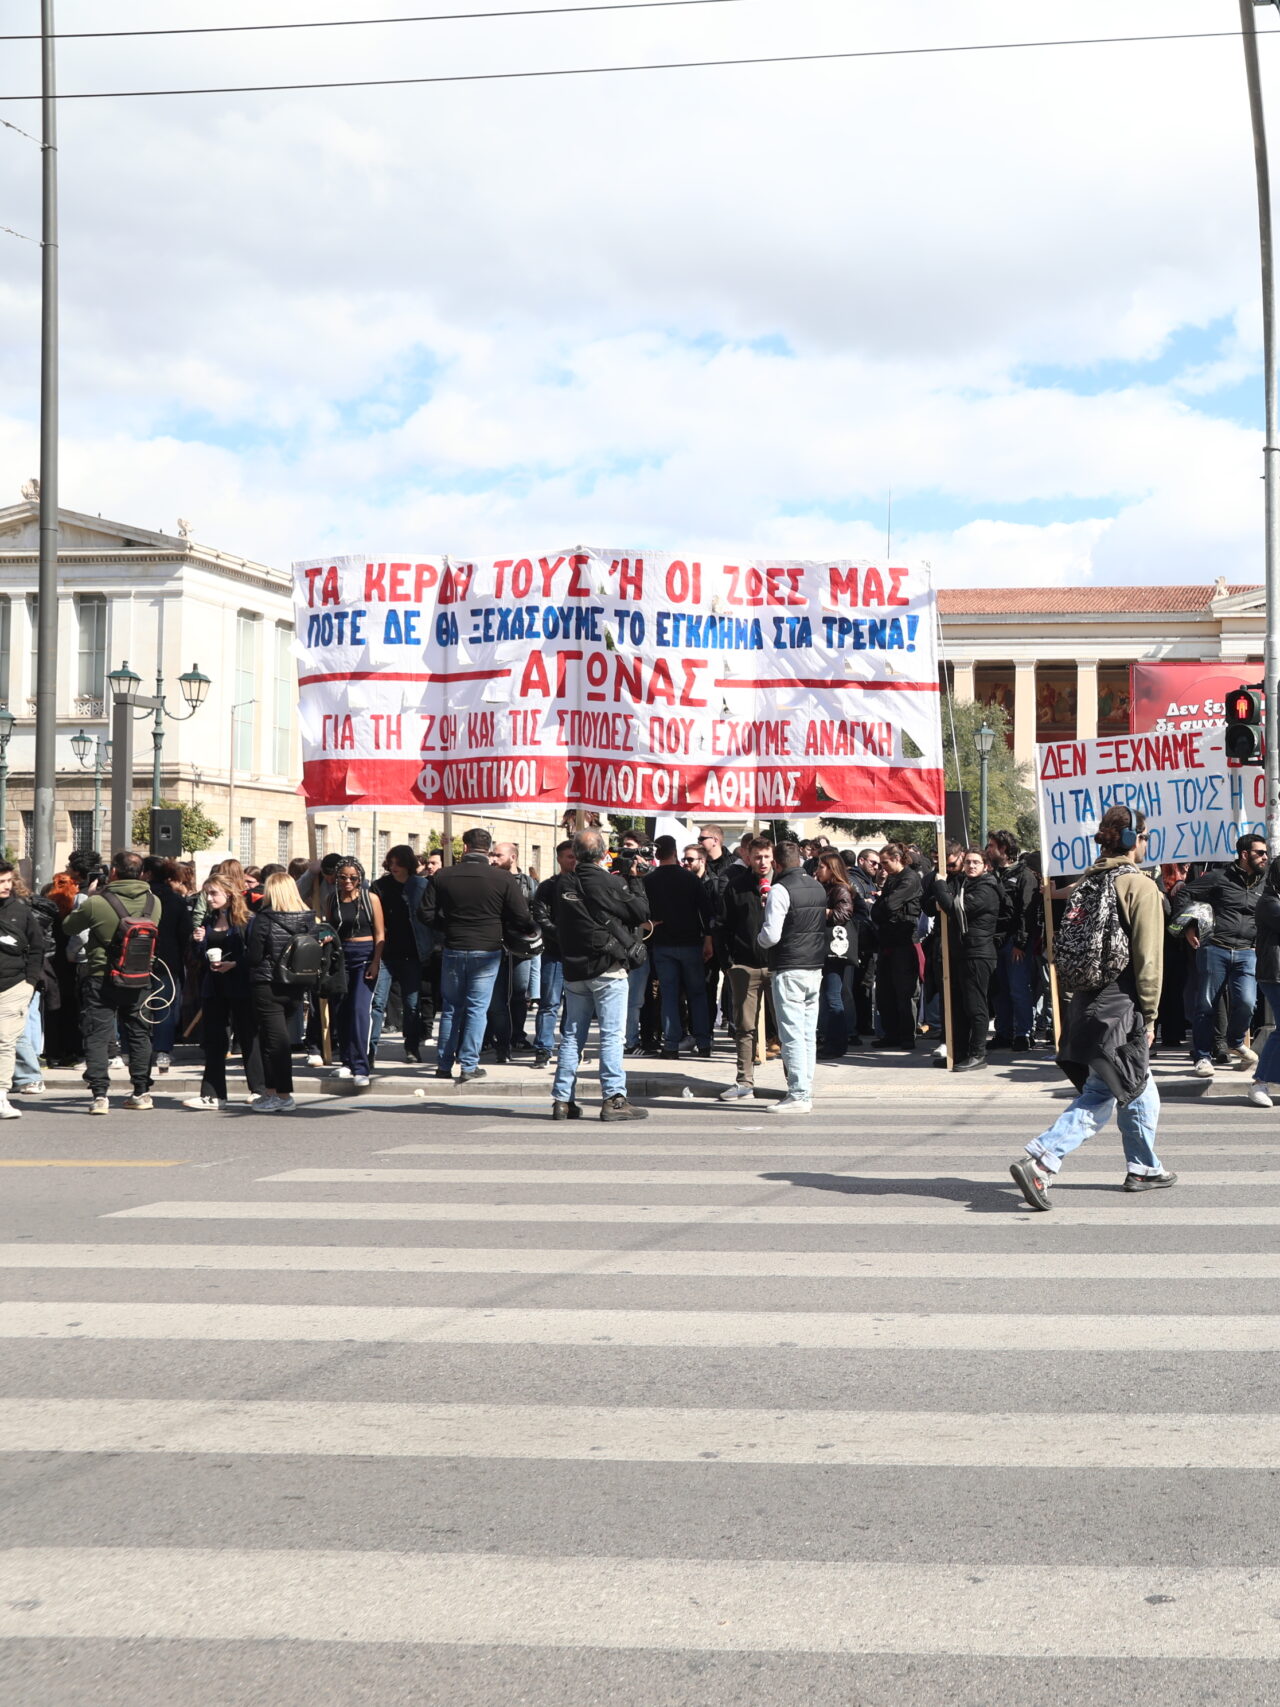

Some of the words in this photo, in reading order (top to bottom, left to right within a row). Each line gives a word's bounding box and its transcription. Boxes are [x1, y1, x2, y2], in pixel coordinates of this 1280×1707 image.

[304, 566, 341, 608] ΤΑ
[364, 562, 473, 605] ΚΕΡΔΗ
[493, 555, 592, 598] ΤΟΥΣ
[665, 560, 701, 605] ΟΙ
[723, 564, 807, 607] ΖΩΕΣ
[829, 567, 910, 607] ΜΑΣ
[307, 610, 367, 649] ΠΟΤΕ
[383, 609, 421, 645] ΔΕ
[436, 610, 459, 648] ΘΑ
[468, 605, 604, 645] ΞΕΧΑΣΟΥΜΕ
[614, 608, 645, 646] ΤΟ
[656, 611, 763, 651] ΕΓΚΛΗΜΑ
[773, 615, 813, 650] ΣΤΑ
[822, 613, 920, 653] ΤΡΕΝΑ!
[520, 649, 708, 707] ΑΓΩΝΑΣ
[322, 714, 355, 752] ΓΙΑ
[370, 714, 401, 750] ΤΗ
[420, 714, 457, 752] ΖΩΗ
[468, 710, 495, 749] ΚΑΙ
[508, 709, 542, 746] ΤΙΣ
[556, 710, 634, 752] ΣΠΟΥΔΕΣ
[650, 717, 695, 755] ΠΟΥ
[711, 719, 791, 757] ΕΧΟΥΜΕ
[805, 719, 893, 757] ΑΝΑΓΚΗ
[1166, 703, 1199, 717] Δεν
[1040, 743, 1087, 780] ΔΕΝ
[1096, 732, 1205, 774] ΞΕΧΝΑΜΕ
[416, 760, 536, 799] ΦΟΙΤΗΤΙΚΟΙ
[565, 761, 680, 806] ΣΥΛΛΟΓΟΙ
[703, 770, 802, 807] ΑΘΗΝΑΣ
[1069, 788, 1095, 823] ΤΑ
[1168, 775, 1224, 815] ΤΟΥΣ
